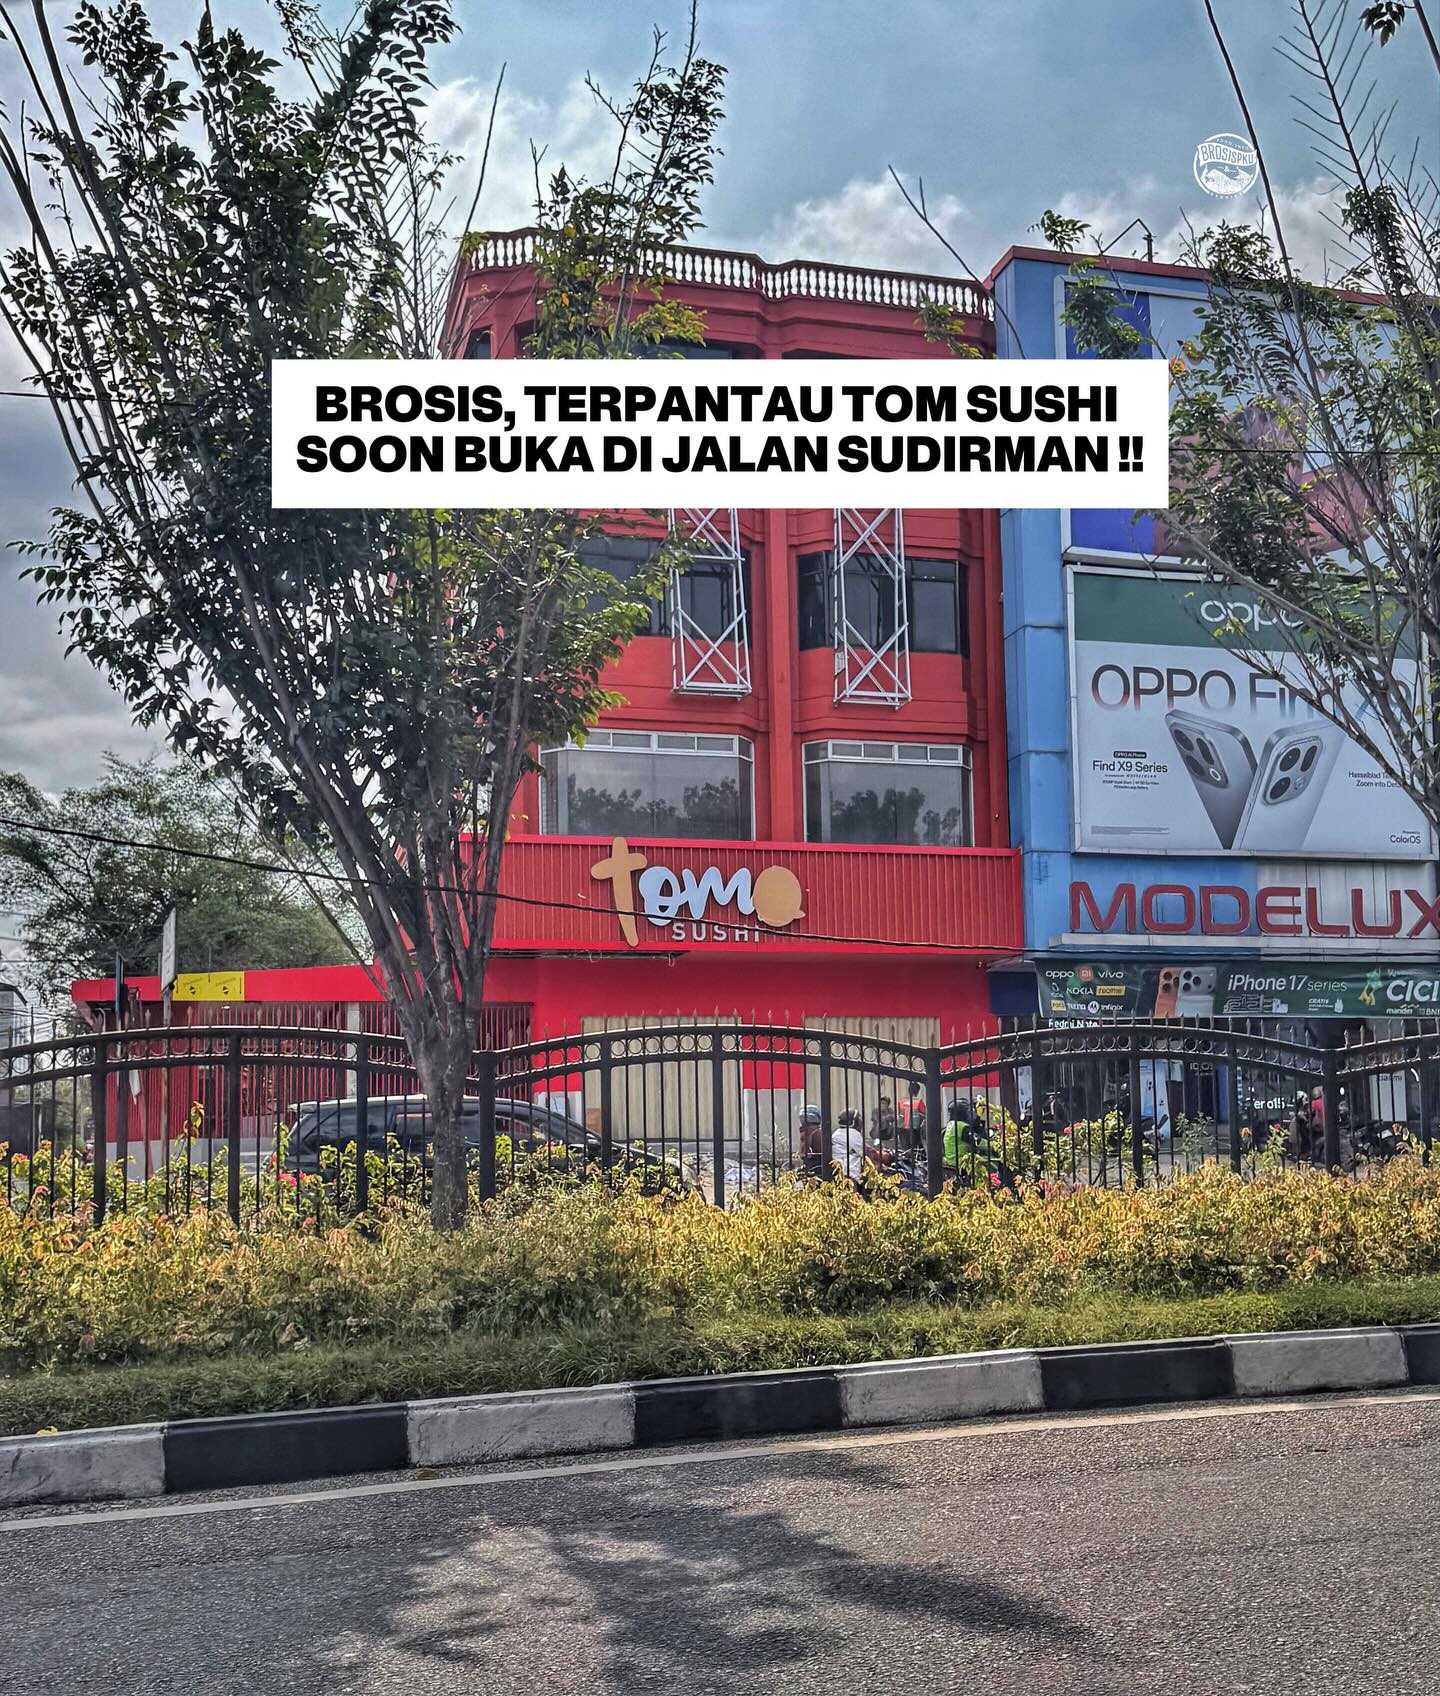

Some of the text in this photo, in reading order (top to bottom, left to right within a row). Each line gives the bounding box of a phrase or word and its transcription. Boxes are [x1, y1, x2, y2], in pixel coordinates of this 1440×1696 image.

[1092, 664, 1236, 711] OPPO
[1092, 760, 1168, 773] Find X9 Series
[1390, 834, 1421, 844] ColorOS
[1069, 881, 1440, 937] MODELUX
[671, 922, 759, 942] SUSHI
[1098, 970, 1124, 979] vivo
[1227, 974, 1348, 991] iPhone 17 series
[1066, 987, 1094, 995] NOKIA
